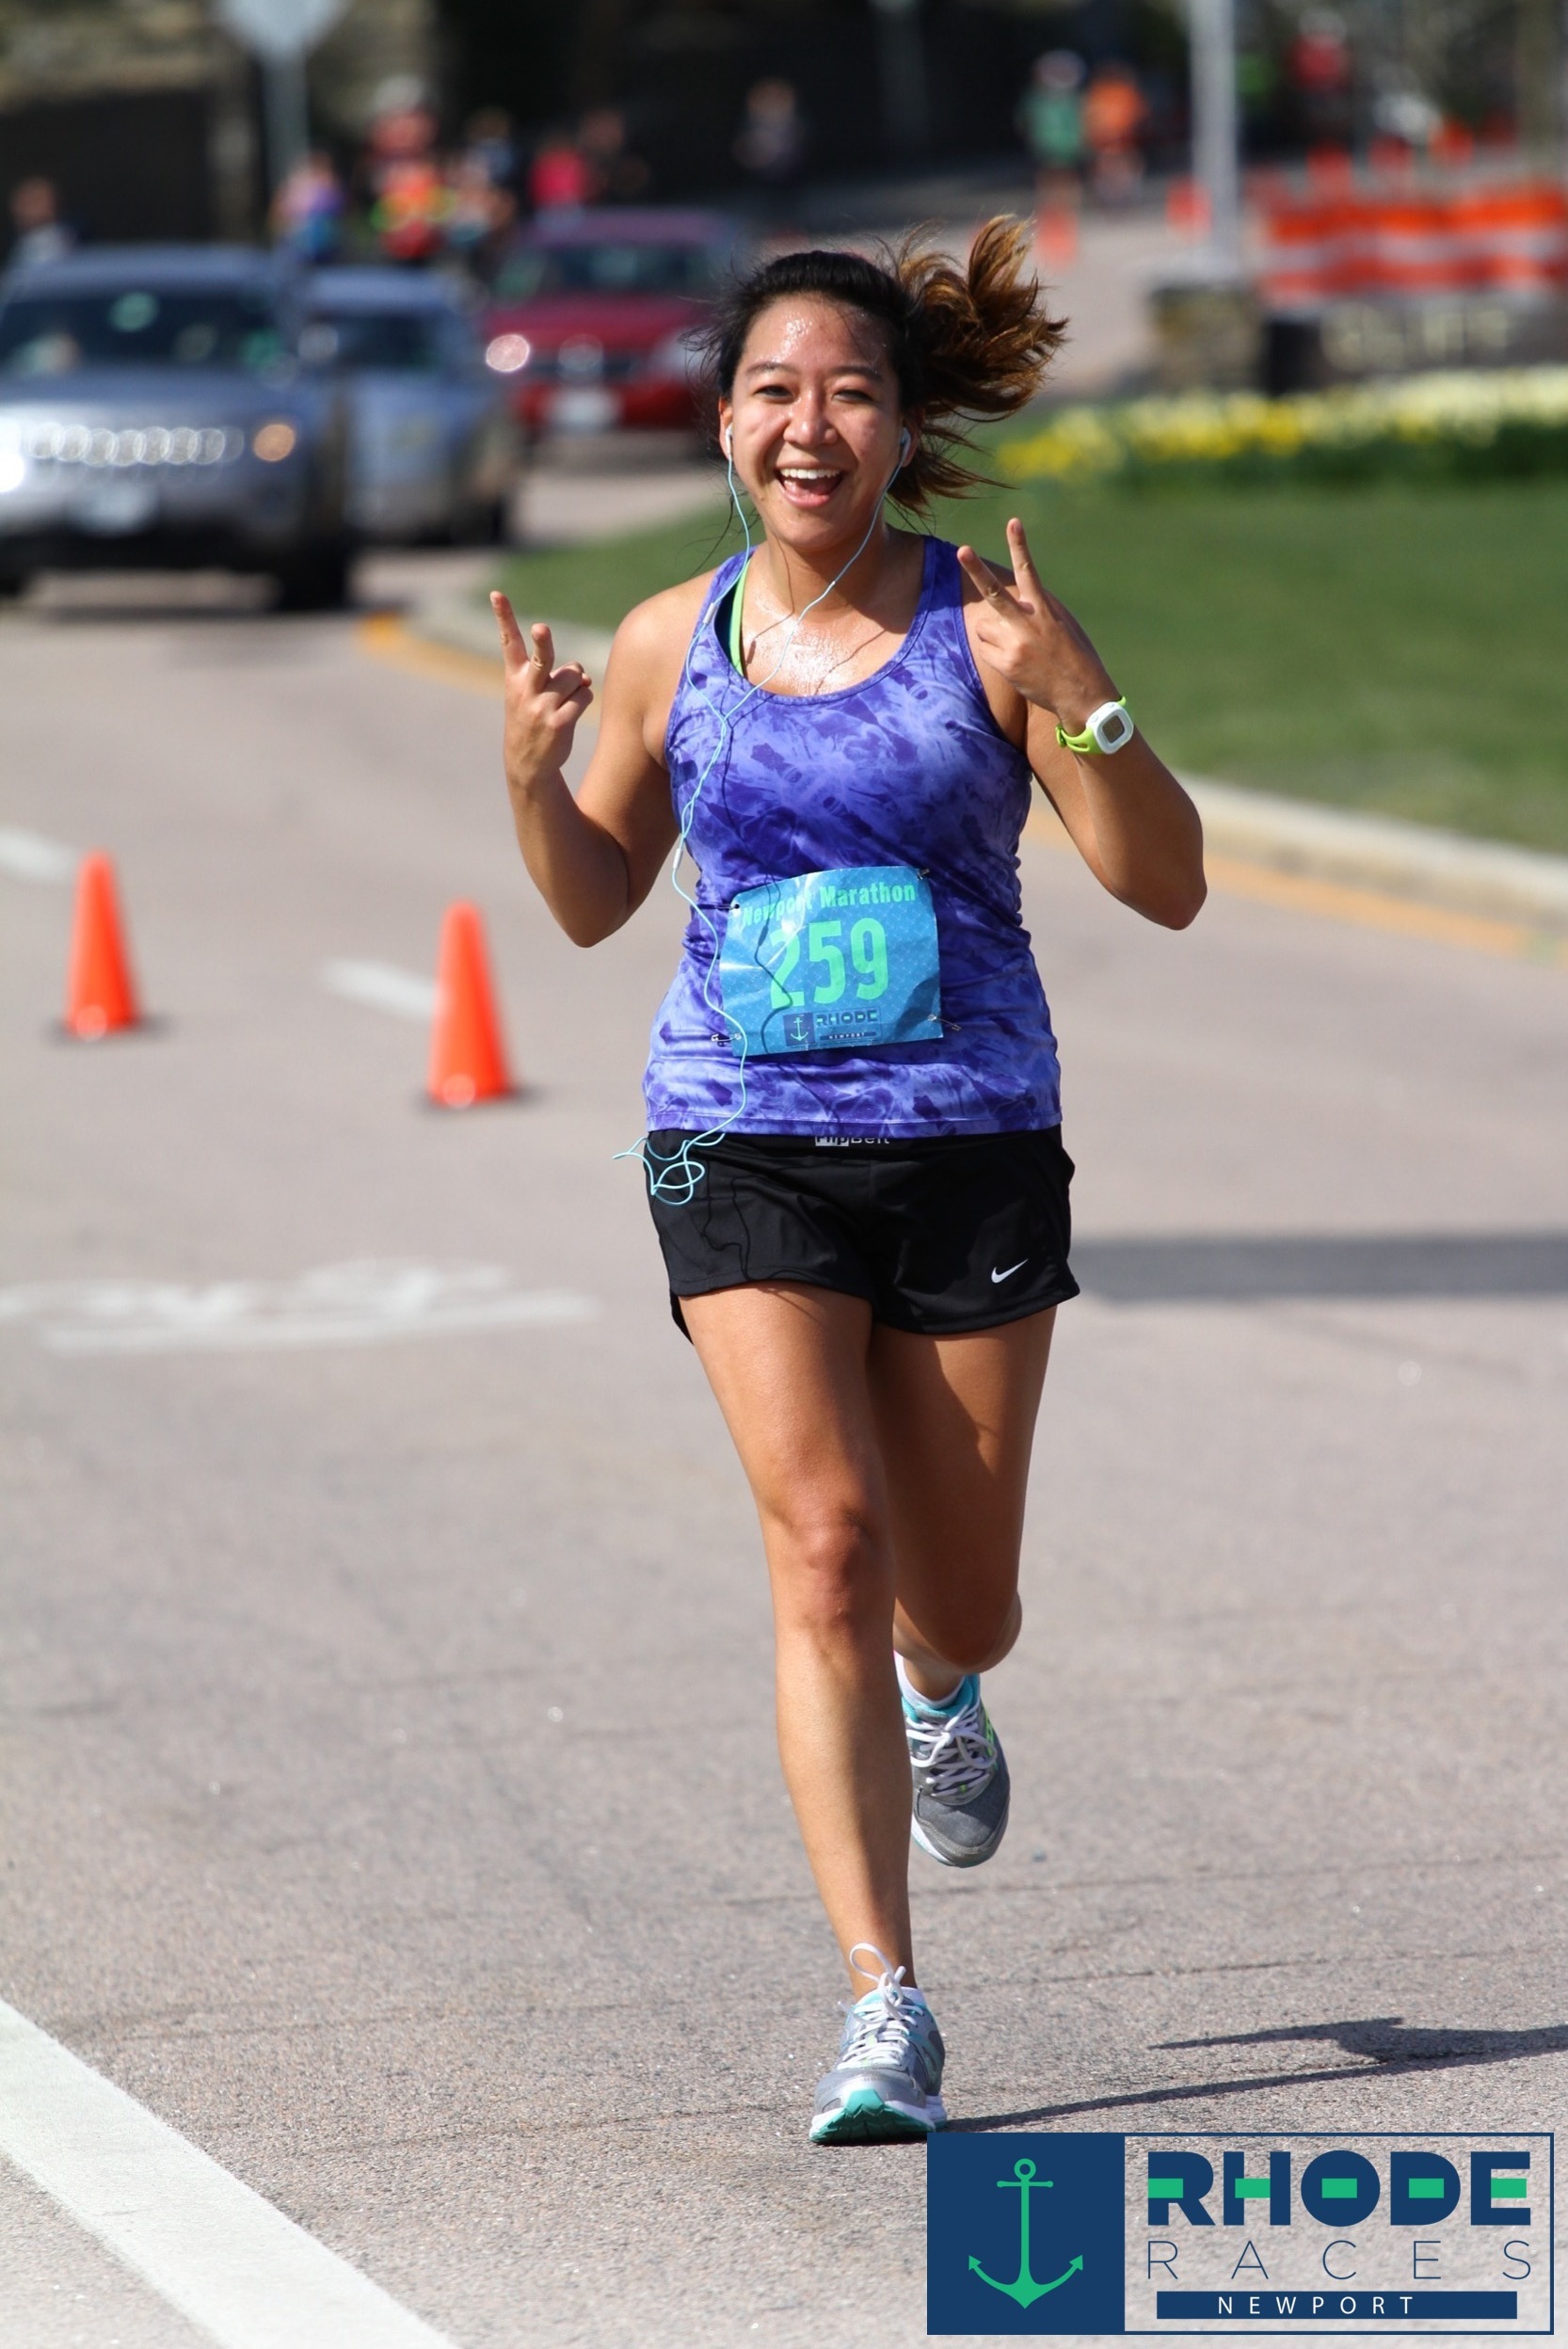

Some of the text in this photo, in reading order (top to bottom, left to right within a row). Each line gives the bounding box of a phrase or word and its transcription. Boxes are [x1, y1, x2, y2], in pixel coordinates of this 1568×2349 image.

[819, 881, 916, 908] Marathon
[769, 917, 888, 1009] 259
[815, 1010, 879, 1027] RHODE
